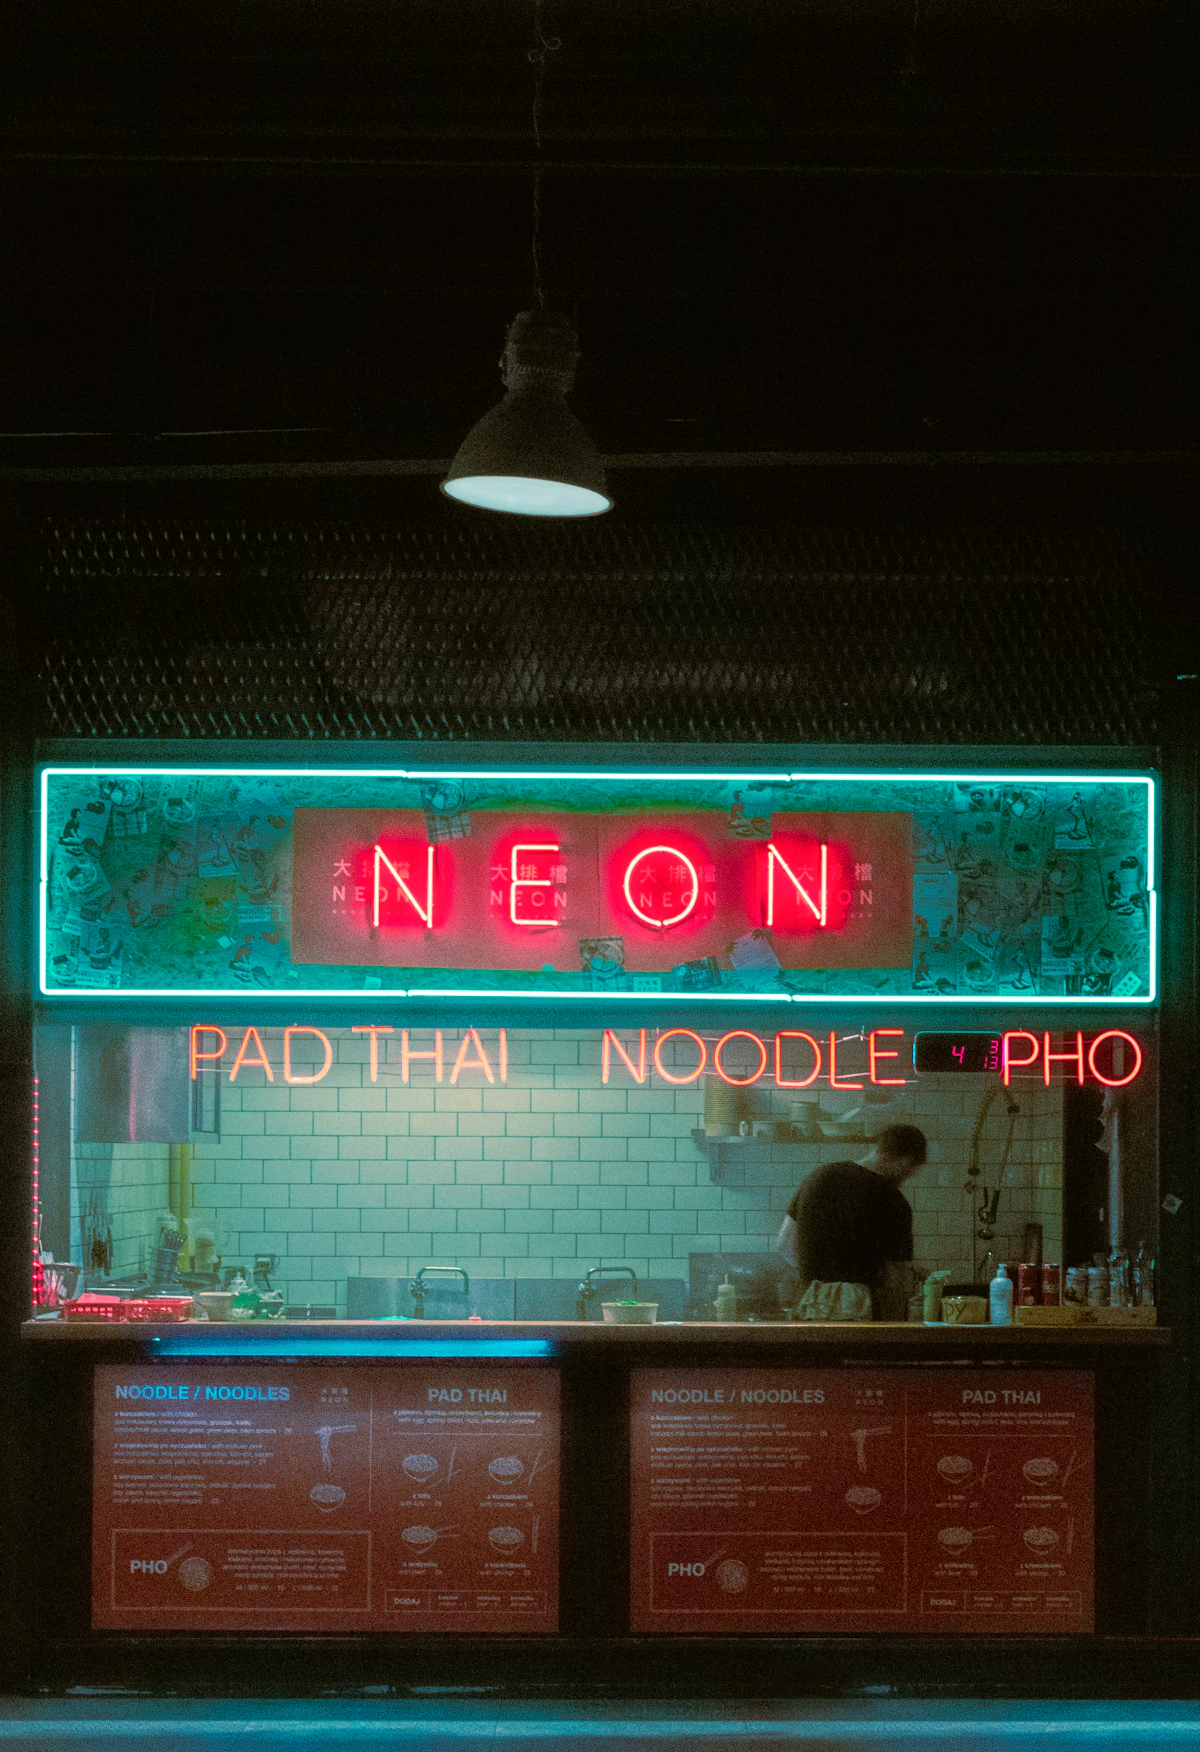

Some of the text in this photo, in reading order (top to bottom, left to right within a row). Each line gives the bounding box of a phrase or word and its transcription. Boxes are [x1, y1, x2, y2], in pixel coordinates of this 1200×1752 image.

[373, 843, 829, 929] NEON
[490, 890, 567, 908] NEON
[639, 891, 717, 908] NEON
[189, 1025, 509, 1085] PAD THAI
[601, 1028, 907, 1090] NOODLE
[1003, 1029, 1143, 1087] PHO
[115, 1385, 189, 1400] NOODLE
[205, 1387, 290, 1401] NOODLES
[427, 1388, 507, 1403] PAD THAI
[651, 1389, 725, 1403] NOODLE
[741, 1389, 825, 1403] NOODLES
[962, 1390, 1041, 1404] PAD THAI
[129, 1559, 168, 1574] PHO
[667, 1562, 706, 1577] PHO
